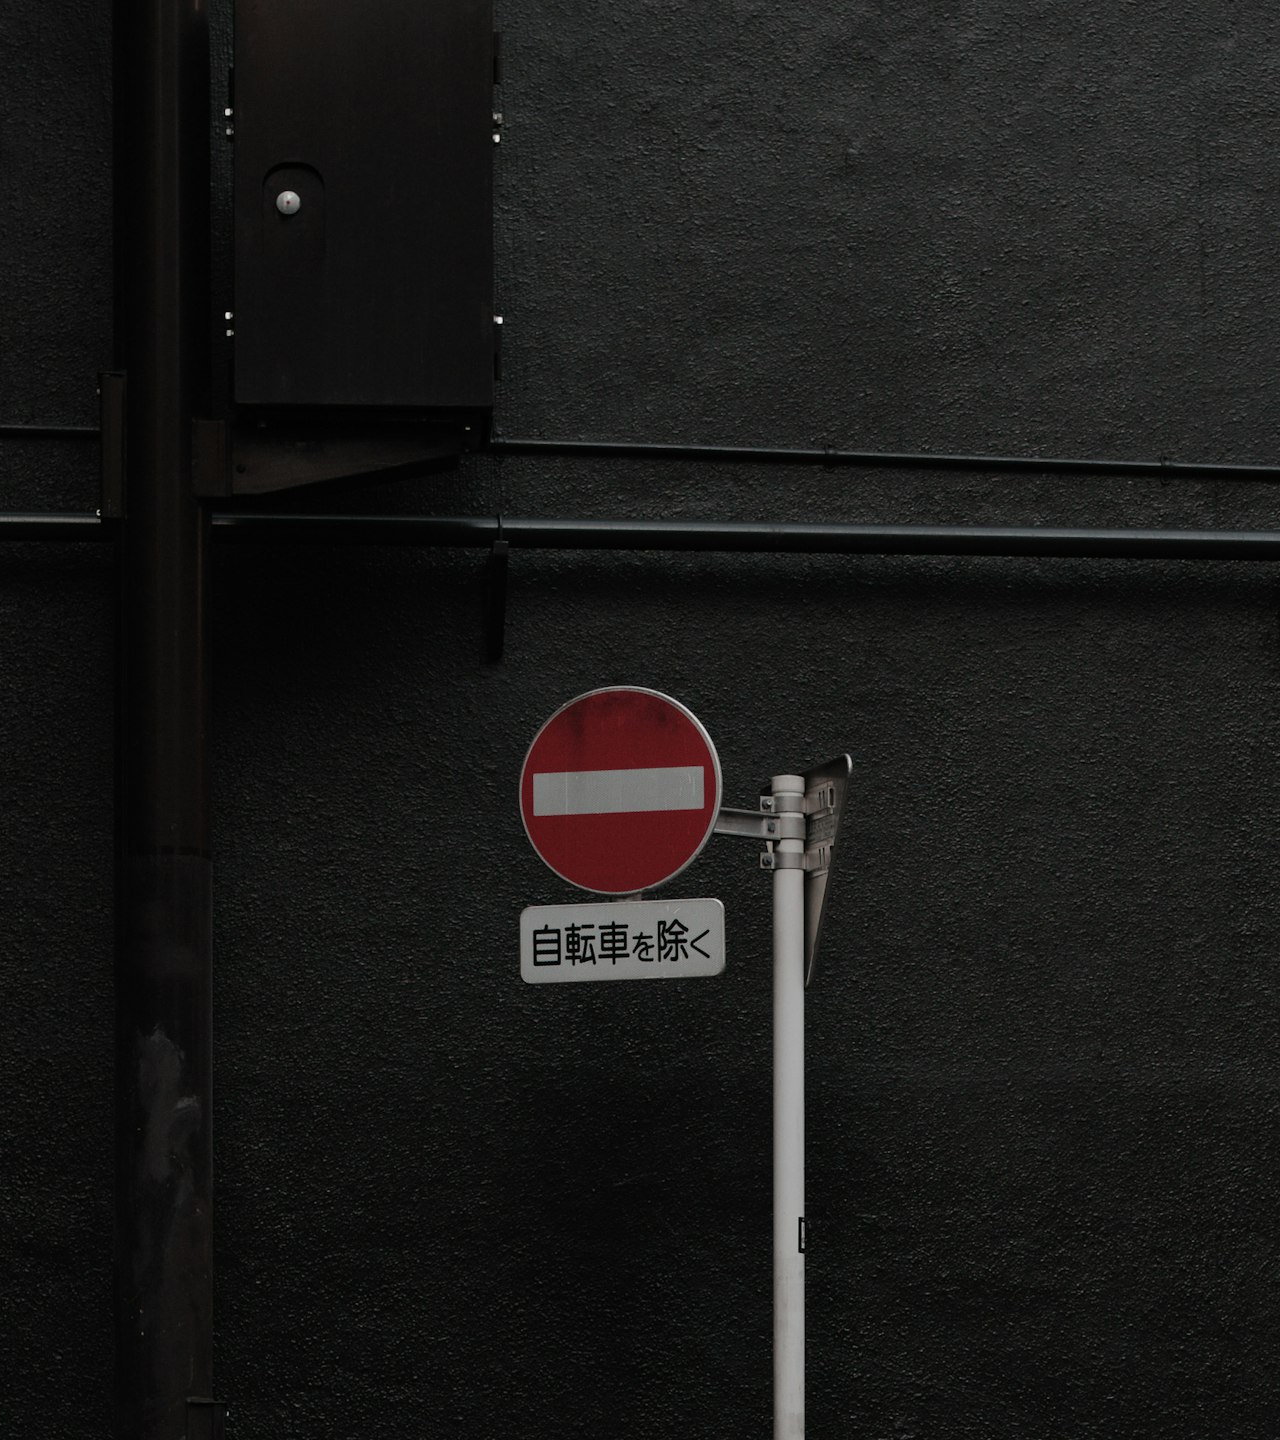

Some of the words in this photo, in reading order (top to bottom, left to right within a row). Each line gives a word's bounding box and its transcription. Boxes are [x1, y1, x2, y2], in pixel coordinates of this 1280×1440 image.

[533, 919, 710, 966] 自転車を除く
